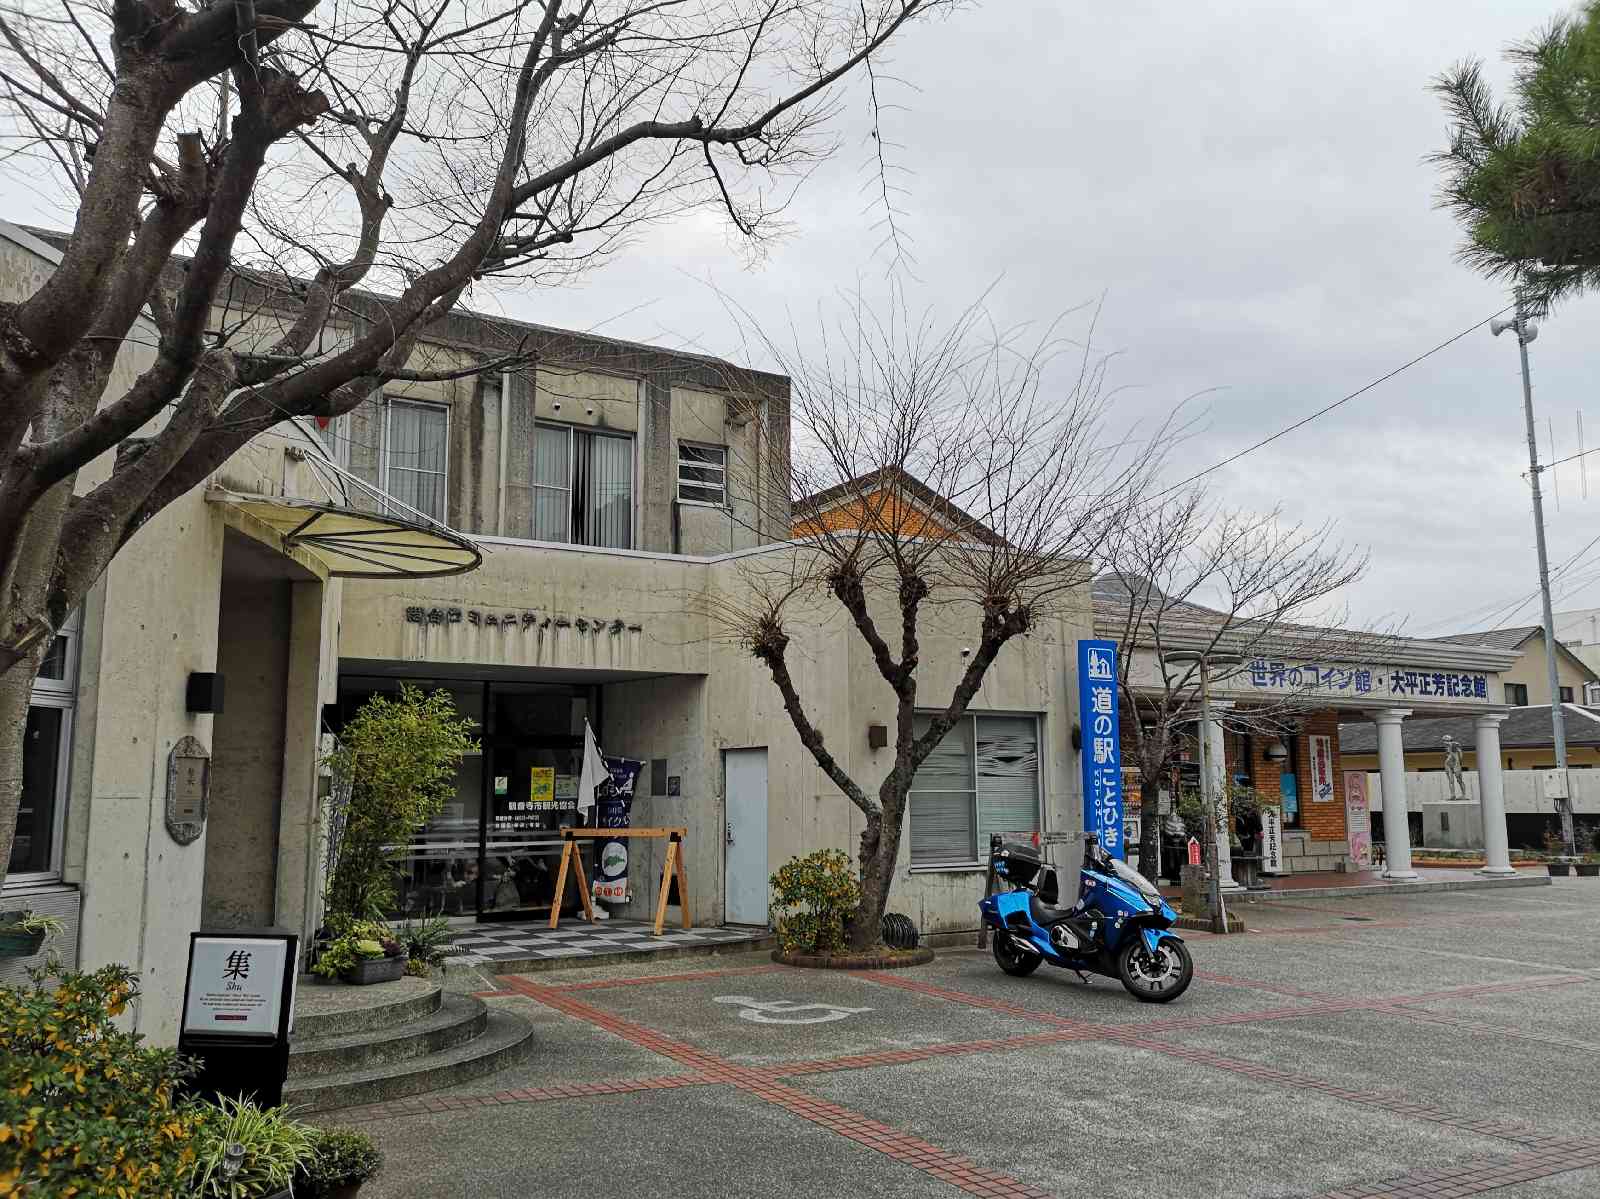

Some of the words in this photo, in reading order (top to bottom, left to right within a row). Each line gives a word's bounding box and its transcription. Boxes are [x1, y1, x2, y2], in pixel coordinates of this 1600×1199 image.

[1091, 686, 1115, 764] 道の駅
[1102, 768, 1119, 848] ことひき
[221, 950, 252, 981] 集
[225, 981, 243, 991] Shu
